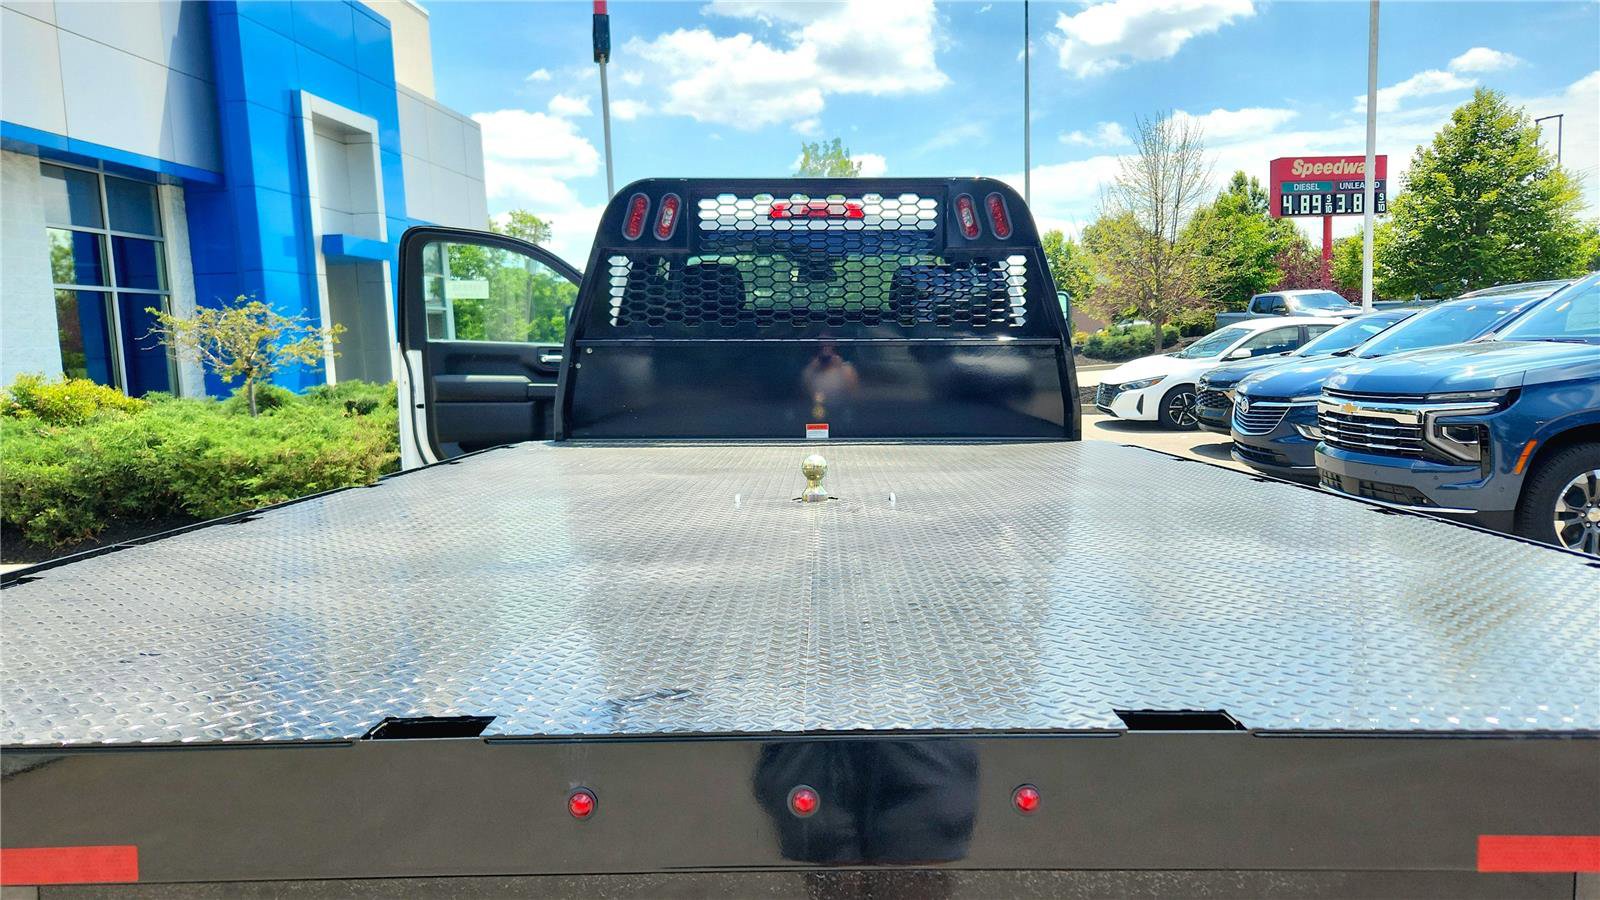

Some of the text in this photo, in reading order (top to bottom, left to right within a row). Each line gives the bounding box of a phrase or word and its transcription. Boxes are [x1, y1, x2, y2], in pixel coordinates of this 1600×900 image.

[1292, 159, 1376, 178] Speedwa
[1293, 183, 1320, 191] DIESEL
[1339, 181, 1381, 189] UNLEAD
[1283, 195, 1322, 214] 4.89
[1336, 193, 1366, 213] 3.8
